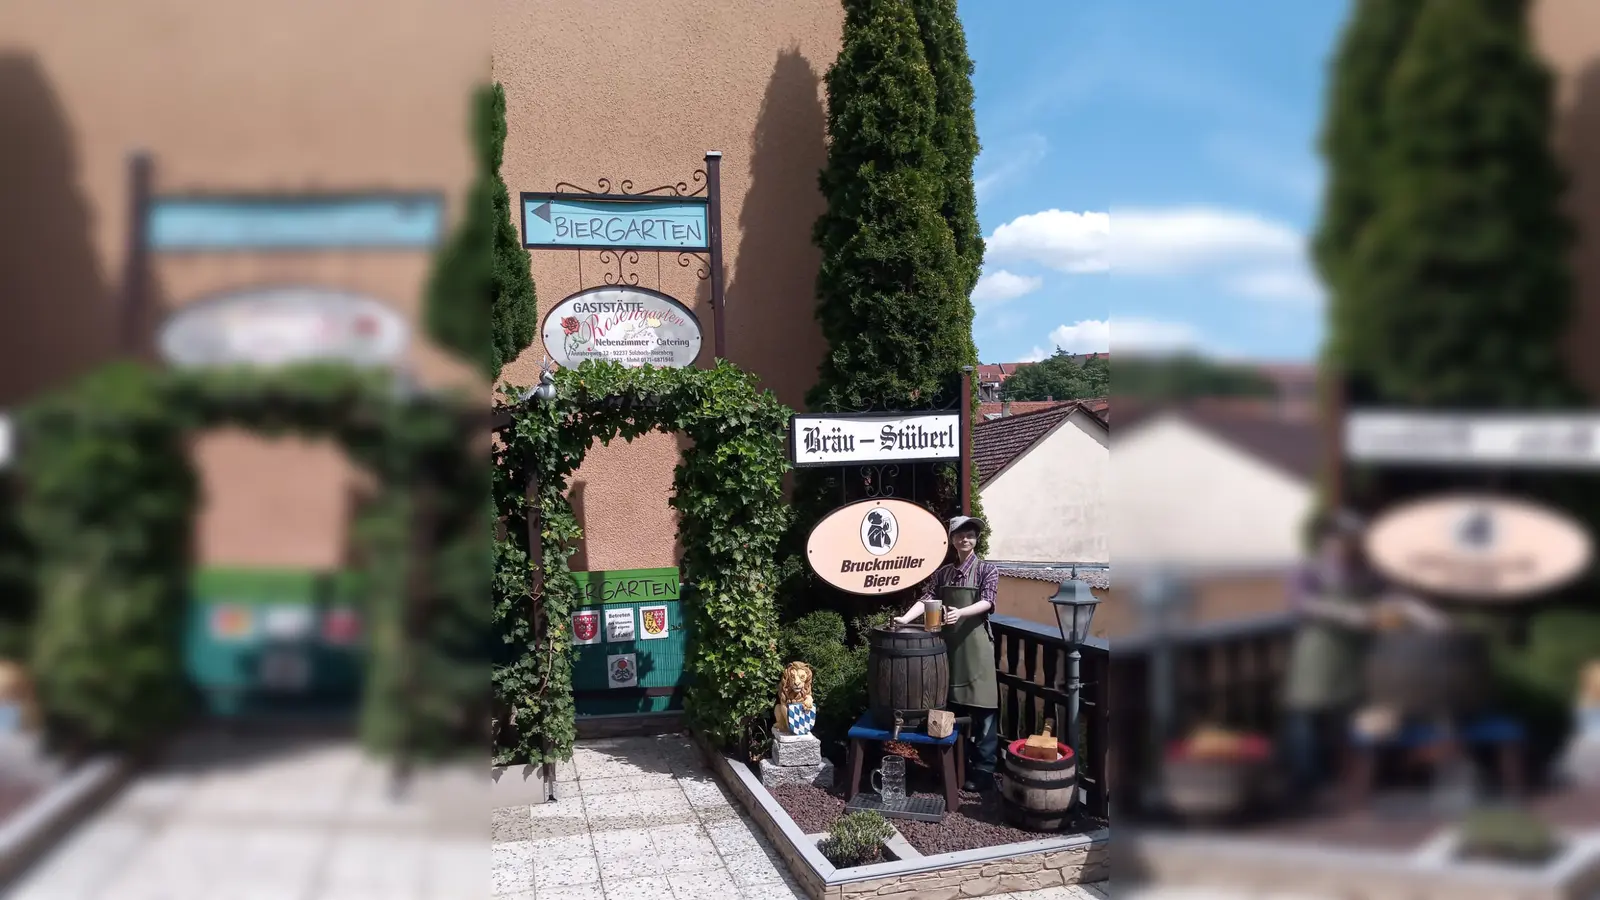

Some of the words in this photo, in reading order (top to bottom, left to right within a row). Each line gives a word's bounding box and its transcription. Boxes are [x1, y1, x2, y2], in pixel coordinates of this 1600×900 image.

[555, 216, 702, 242] BIERGARTEN
[573, 300, 644, 313] GASTSTÄTTE
[580, 308, 685, 351] Rosengarten
[595, 338, 650, 347] Nebenzimmer
[656, 337, 690, 348] Catering
[803, 426, 855, 454] Bräu
[879, 424, 954, 451] Stüberl
[841, 556, 925, 573] Bruckmüller
[863, 574, 900, 588] Biere
